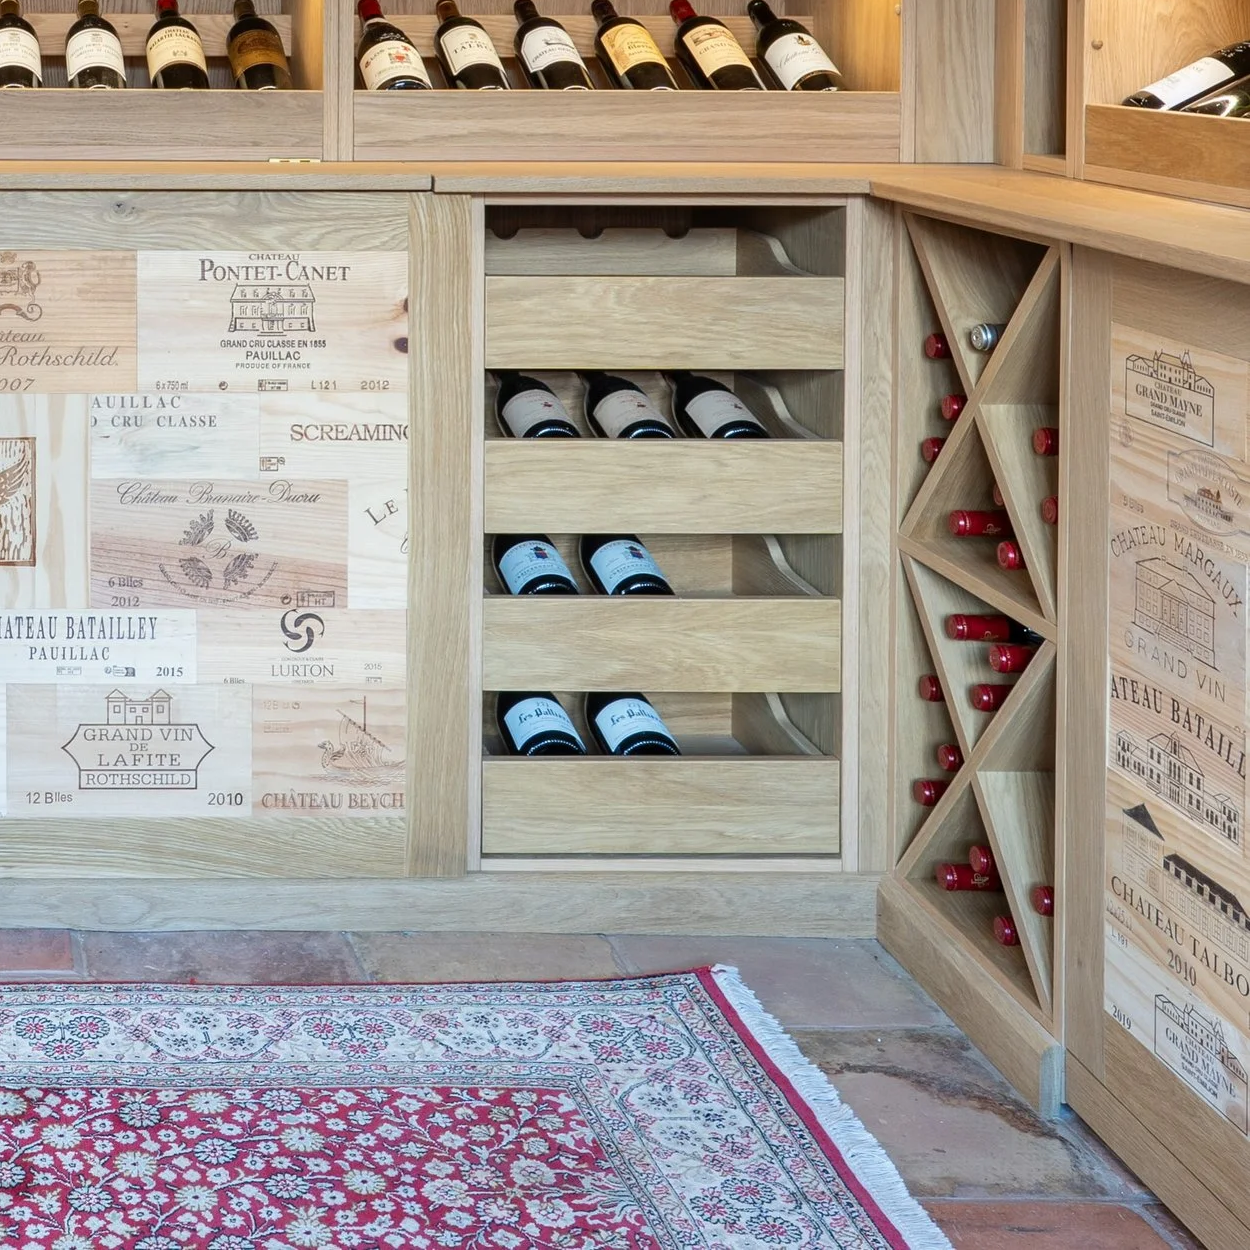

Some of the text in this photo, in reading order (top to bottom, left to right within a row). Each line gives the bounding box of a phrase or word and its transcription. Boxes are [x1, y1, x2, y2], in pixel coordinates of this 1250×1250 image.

[199, 258, 350, 282] PONTET-CANET
[220, 339, 247, 348] GRAND
[249, 339, 265, 348] CRU
[297, 339, 308, 348] EN
[310, 339, 327, 348] 1855
[245, 351, 301, 361] PAUILLAC
[360, 380, 390, 390] 2012
[1135, 383, 1203, 417] GRAND MAYNE
[111, 415, 143, 428] CRU
[156, 415, 217, 428] CLASSE
[116, 479, 321, 505] Château Branaire-Ducru
[363, 499, 399, 526] LE
[1111, 526, 1243, 609] CHATEAU MARGAUX
[111, 596, 141, 607] 2012
[66, 616, 159, 640] BATAILLEY
[29, 646, 111, 660] PAUILLAC
[156, 667, 183, 677] 2015
[271, 664, 334, 677] LURTON
[1124, 630, 1226, 703] GRAND VIN
[83, 728, 193, 741] GRAND VIN
[129, 742, 148, 751] DE
[98, 754, 180, 766] LAFITE
[85, 773, 191, 785] ROTHSCHILD
[26, 792, 40, 803] 12
[208, 792, 243, 805] 2010
[261, 788, 405, 809] CHÂTEAU BEYCH
[1111, 876, 1250, 997] CHATEAU TALBO
[1166, 948, 1197, 987] 2010
[1112, 1005, 1132, 1030] 2019
[1165, 1027, 1199, 1064] GRAND
